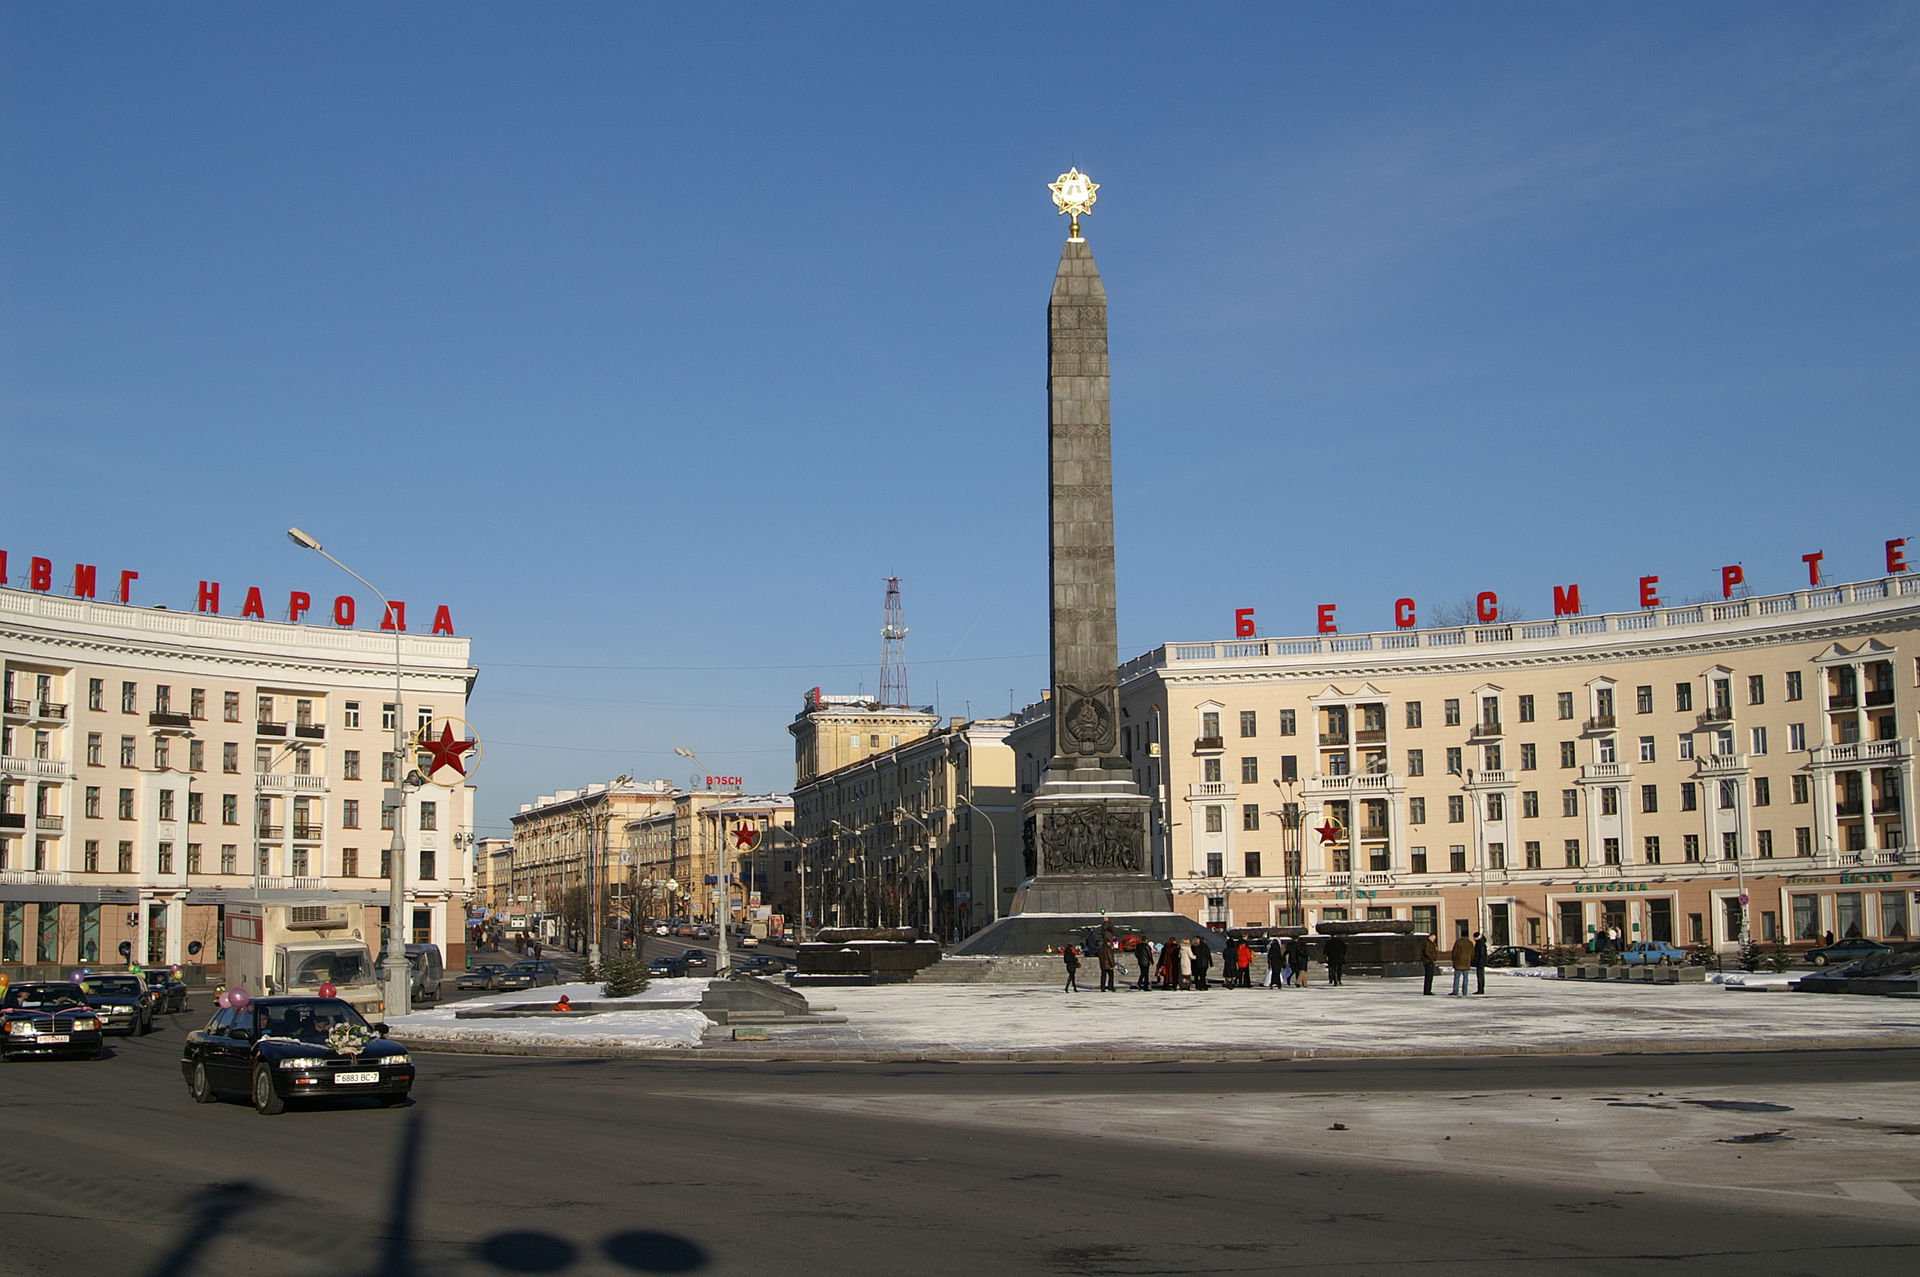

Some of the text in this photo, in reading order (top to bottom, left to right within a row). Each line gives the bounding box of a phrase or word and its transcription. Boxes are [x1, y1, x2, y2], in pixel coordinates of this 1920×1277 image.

[1235, 538, 1907, 637] БЕССМЕРТЕ
[198, 581, 455, 635] НАРОДА
[706, 776, 742, 785] BOSCH
[1575, 882, 1648, 893] БЯРОЗКА
